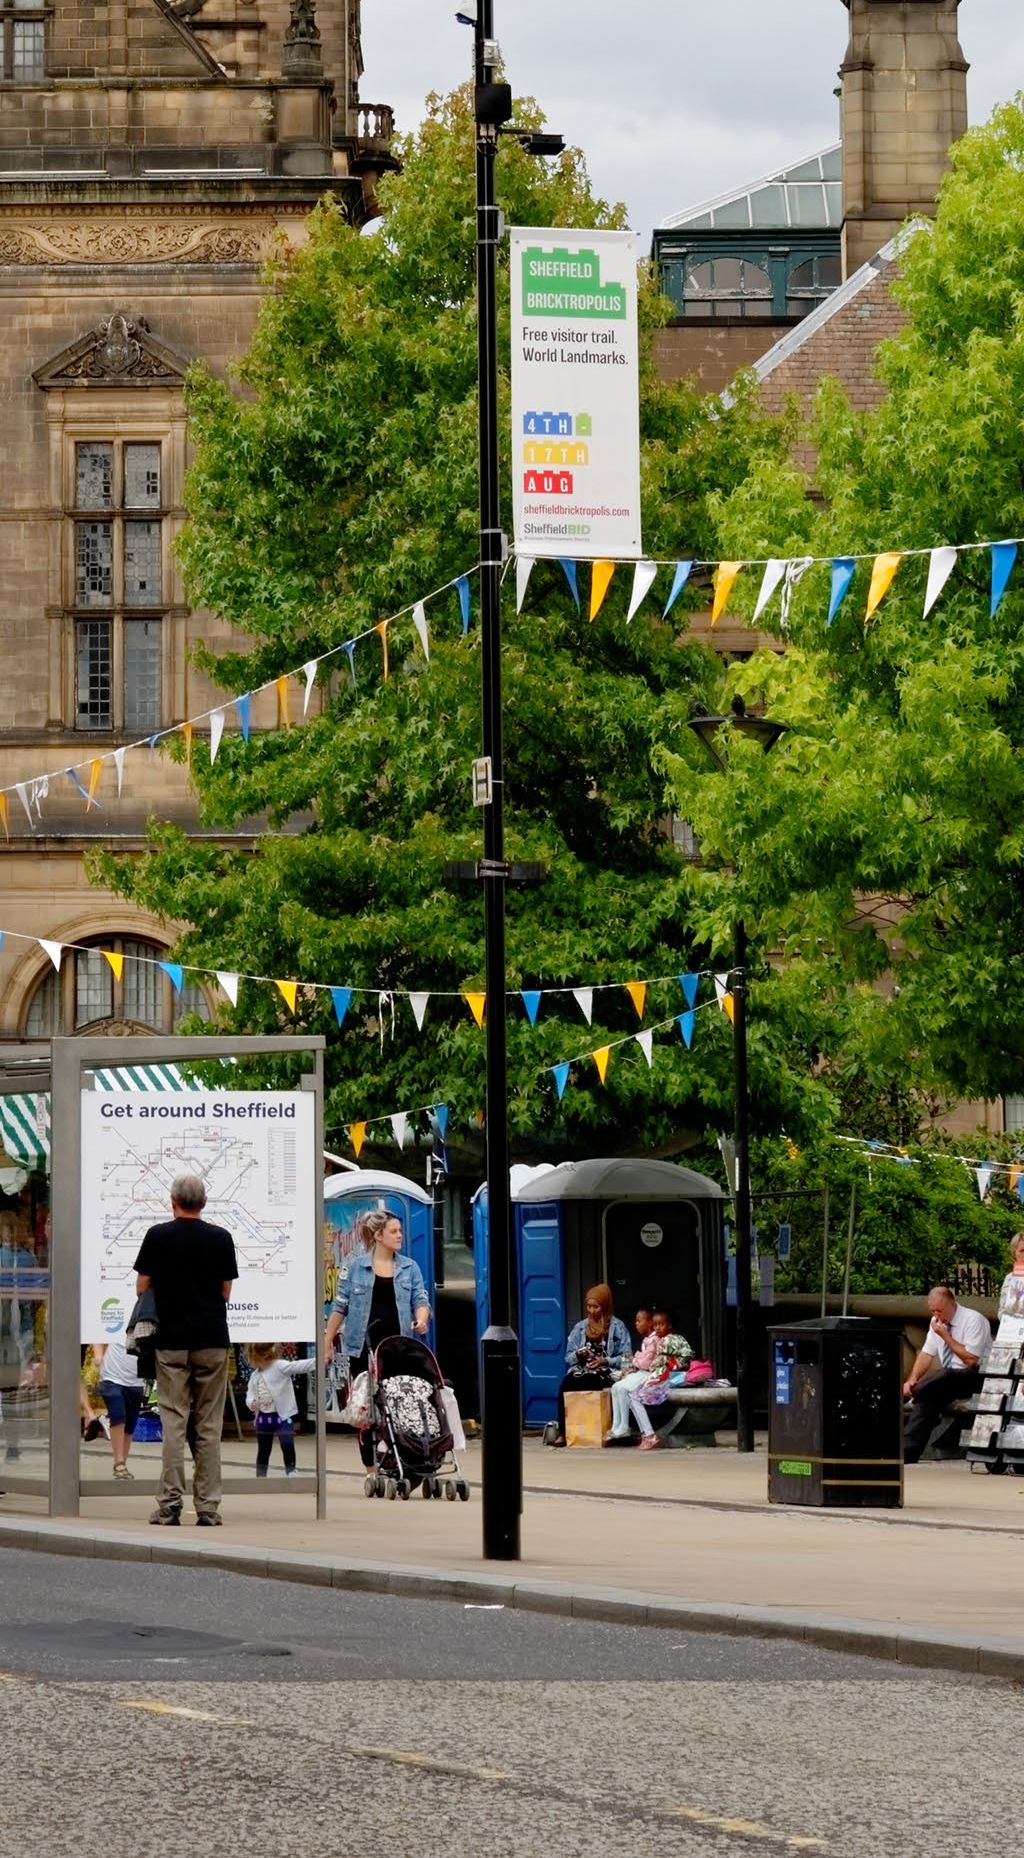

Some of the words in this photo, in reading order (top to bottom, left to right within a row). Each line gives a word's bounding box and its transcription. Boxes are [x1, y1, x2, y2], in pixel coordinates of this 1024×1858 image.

[529, 260, 592, 278] SHEFFIELD
[527, 292, 621, 311] BRICKTROPOLIS
[522, 326, 548, 342] Free
[551, 328, 588, 343] visitor
[591, 330, 618, 344] trail.
[522, 347, 557, 362] World
[560, 348, 629, 365] Landmarks.
[527, 418, 568, 433] 4TH
[527, 477, 568, 492] AUG
[523, 504, 630, 518] sheffieldbricktropolis.com
[100, 1103, 133, 1118] Get
[139, 1102, 206, 1118] around
[212, 1102, 296, 1118] Sheffield
[227, 1302, 259, 1311] buses
